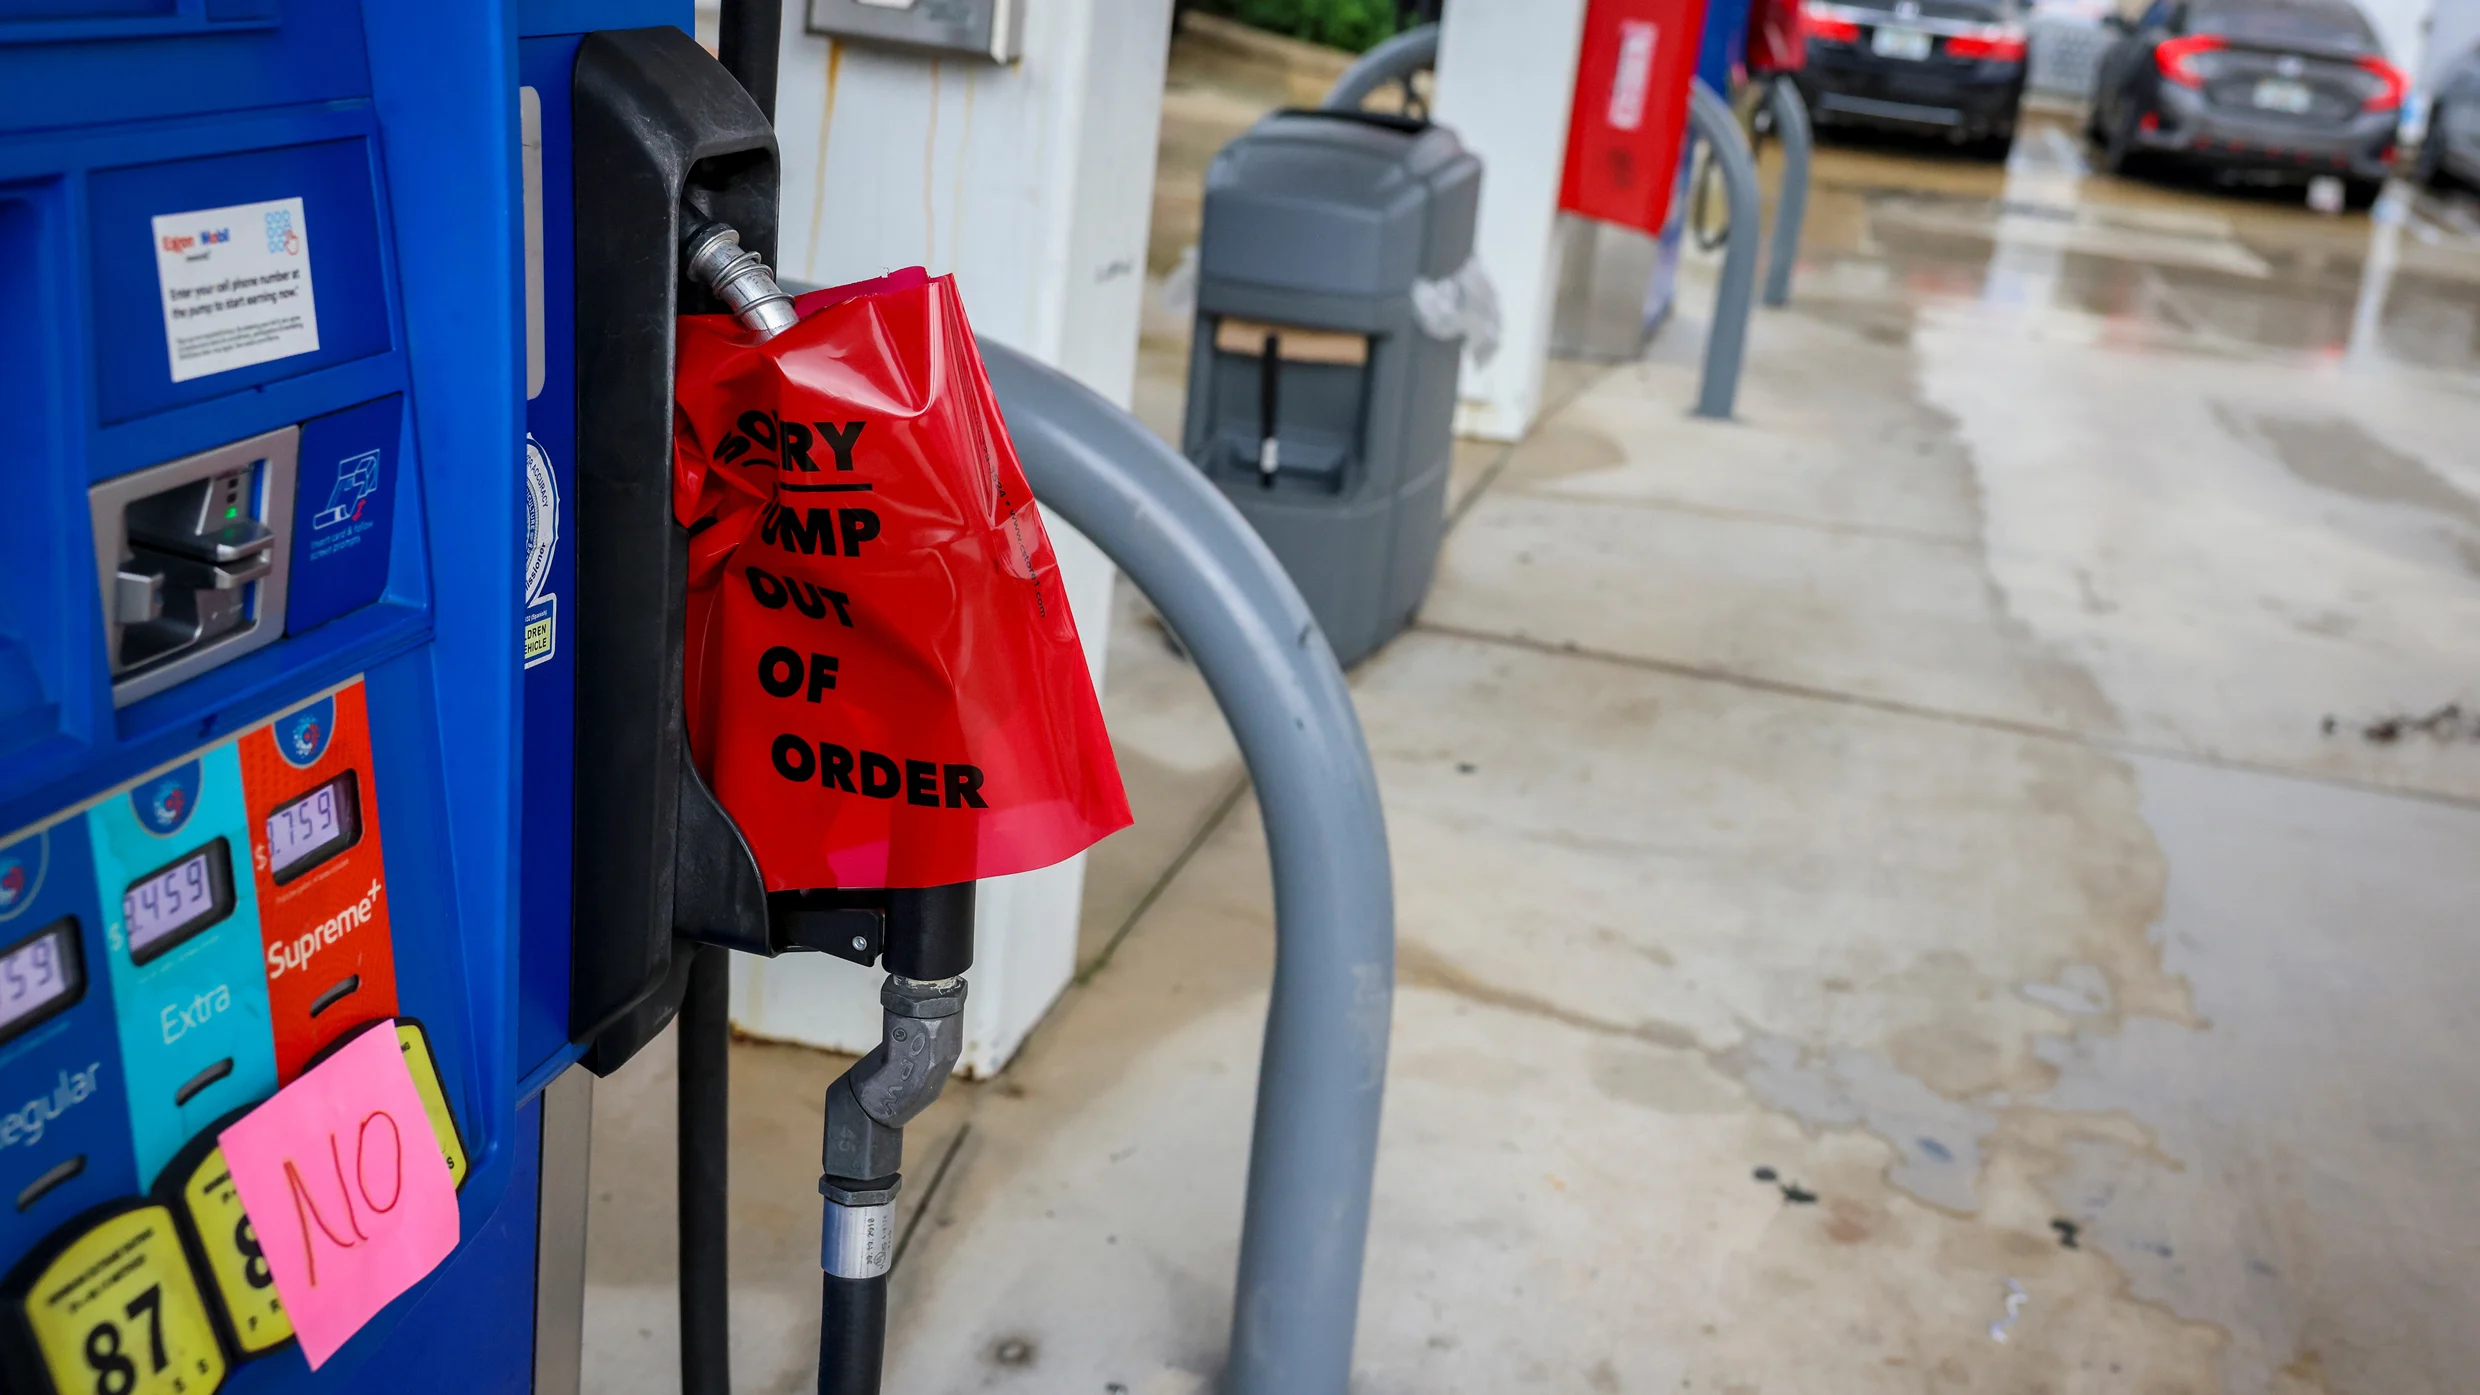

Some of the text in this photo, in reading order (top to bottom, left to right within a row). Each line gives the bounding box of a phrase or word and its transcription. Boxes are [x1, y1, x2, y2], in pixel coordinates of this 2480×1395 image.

[200, 228, 230, 245] Mobil
[169, 269, 300, 301] Enter your cell phone number at
[172, 306, 186, 319] the
[190, 303, 212, 318] pump
[215, 300, 223, 311] to
[226, 296, 244, 309] start
[247, 291, 277, 305] earning
[713, 410, 867, 472] SORY
[532, 464, 548, 507] ACCURACY
[761, 501, 881, 557] UMP
[525, 542, 546, 590] issioner
[745, 565, 854, 629] OUT
[525, 623, 547, 641] DREN
[525, 637, 547, 655] EHICLE
[758, 646, 839, 704] OF
[770, 733, 989, 809] ORDER
[159, 984, 231, 1045] Extra
[0, 1062, 100, 1148] egular
[283, 1110, 401, 1288] NO
[235, 1213, 274, 1289] 8
[85, 1281, 169, 1395] 87
